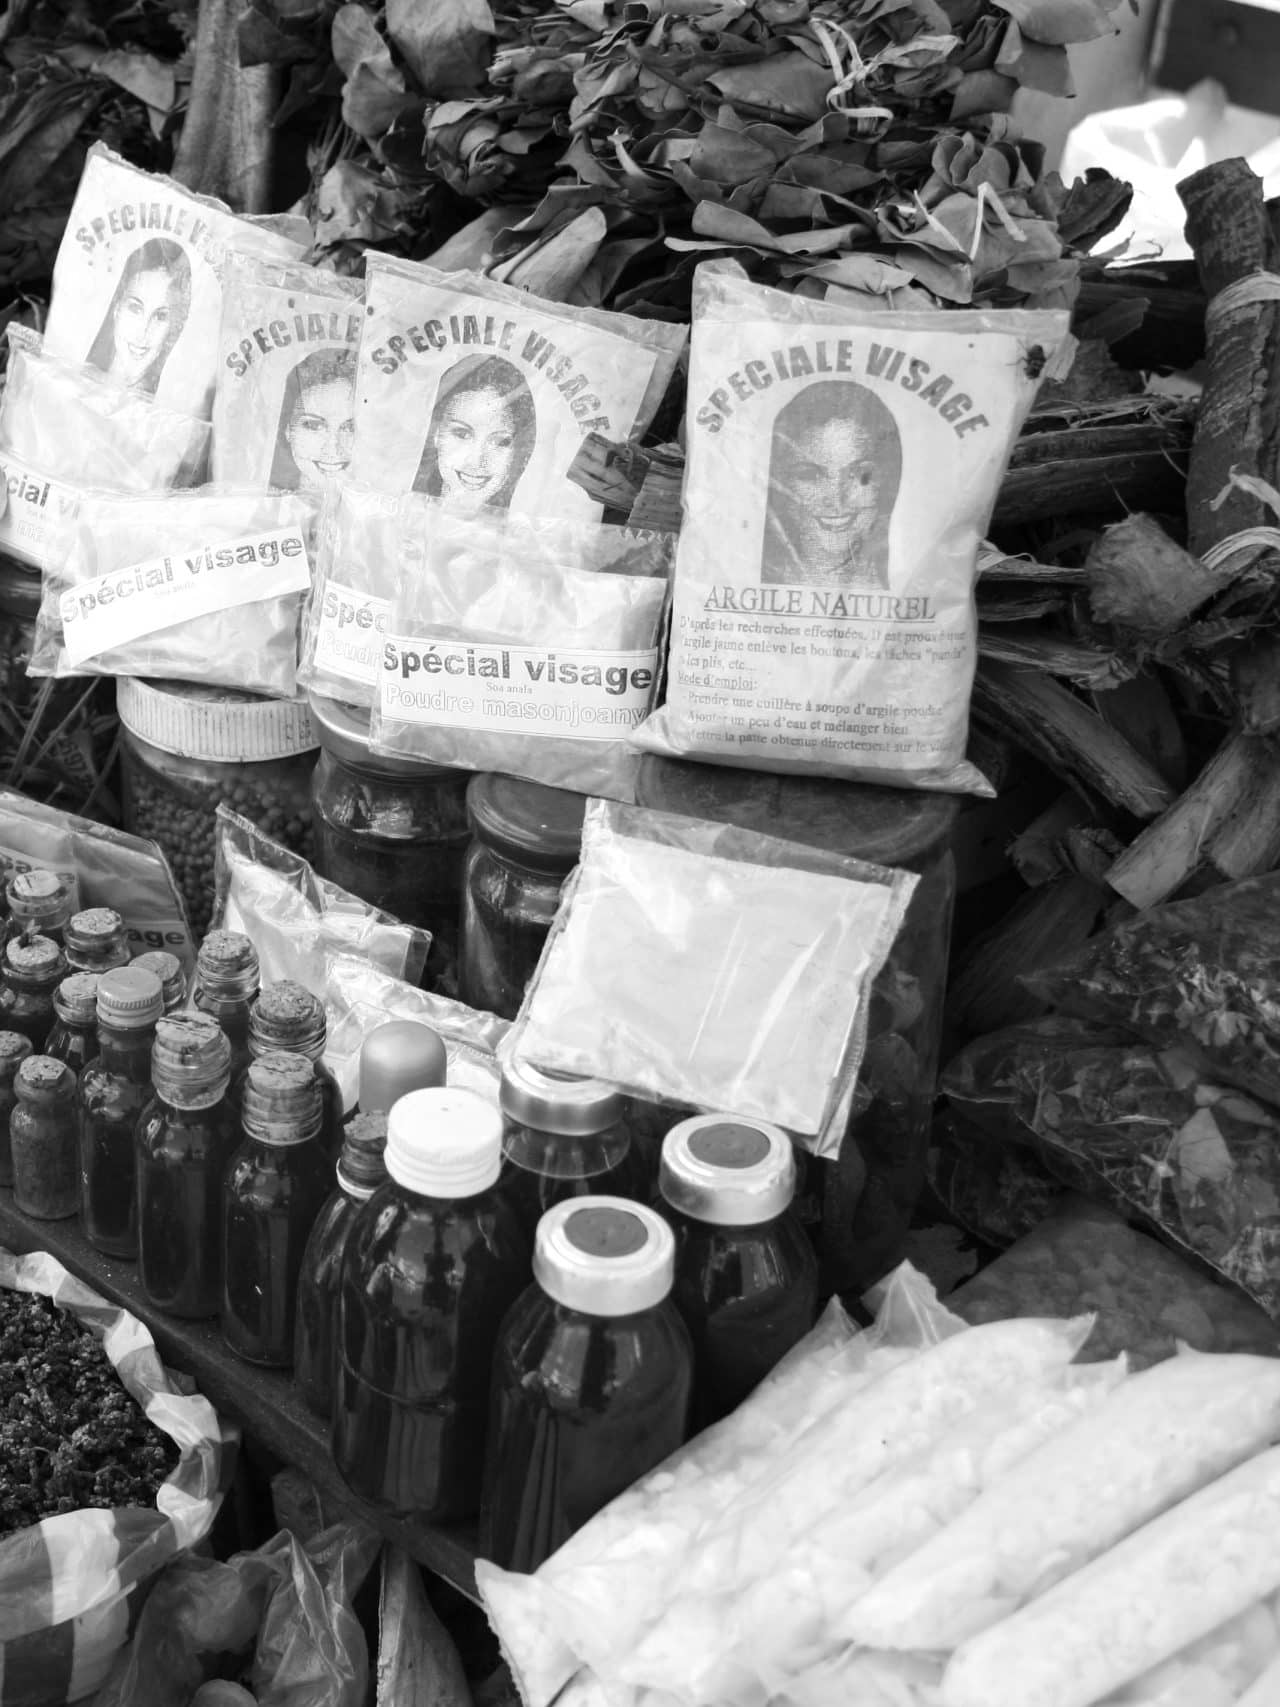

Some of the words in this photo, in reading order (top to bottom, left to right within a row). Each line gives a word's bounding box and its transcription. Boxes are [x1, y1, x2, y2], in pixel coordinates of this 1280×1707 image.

[75, 202, 189, 252] SPECIALE
[226, 312, 361, 377] SPECIALE
[521, 329, 611, 435] VISAGE
[696, 340, 853, 433] SPECIALE
[865, 342, 989, 439] VISAGE
[7, 473, 51, 507] cial
[63, 557, 174, 622] Spécial
[185, 537, 303, 575] visage
[323, 592, 386, 633] Spéc
[704, 585, 803, 614] ARGILE
[809, 591, 936, 620] NATUREL
[719, 618, 735, 631] les
[738, 621, 801, 635] recherches
[384, 643, 510, 678] Spécial
[525, 655, 652, 695] visage
[791, 642, 807, 655] les
[386, 683, 473, 713] Poudre
[482, 697, 647, 730] masonjoany
[733, 697, 753, 709] une
[816, 702, 851, 717] soupe
[749, 718, 770, 730] peu
[774, 715, 808, 730] d'eau
[810, 719, 822, 730] et
[824, 720, 881, 737] mélanger
[127, 928, 185, 949] age
